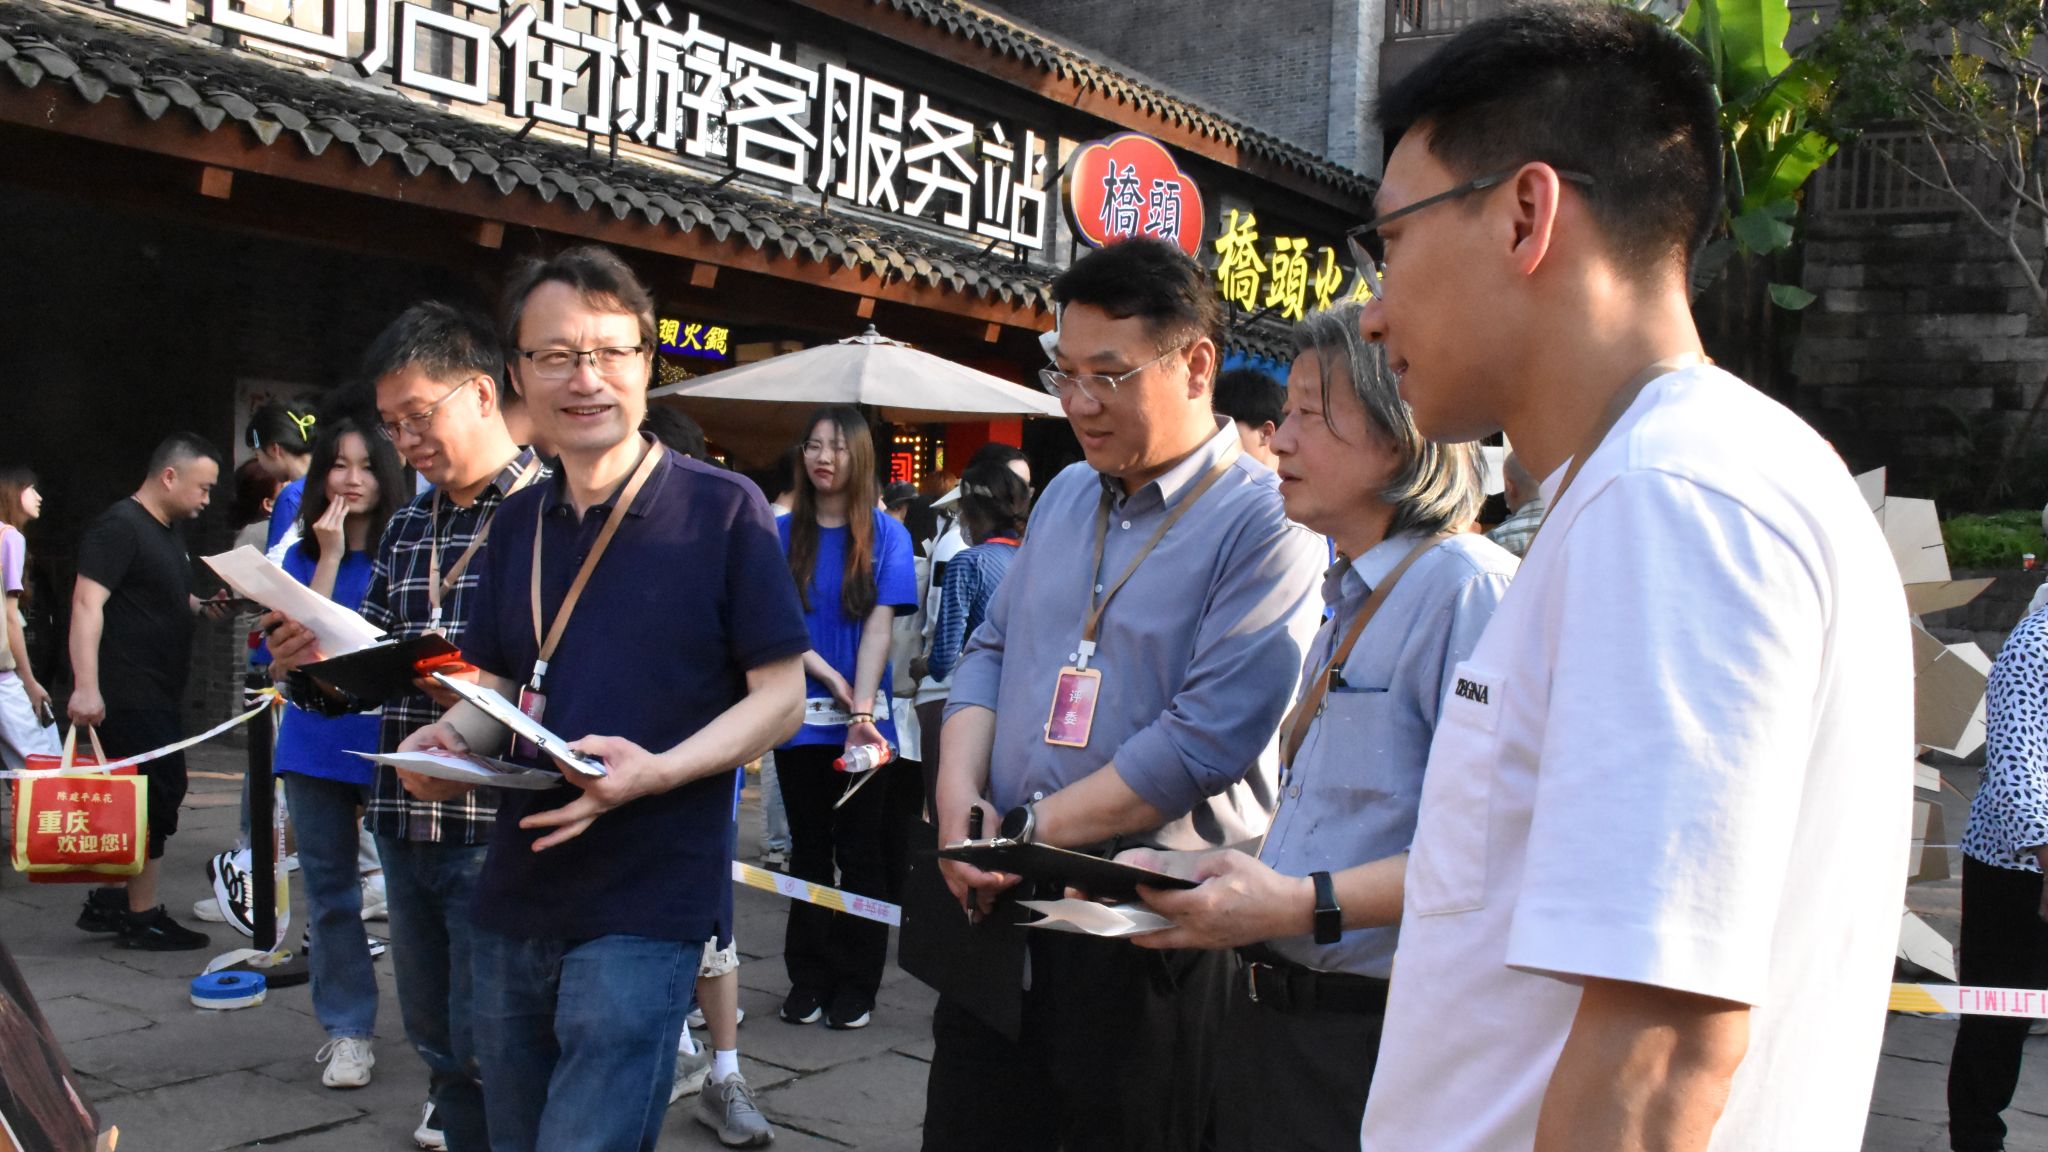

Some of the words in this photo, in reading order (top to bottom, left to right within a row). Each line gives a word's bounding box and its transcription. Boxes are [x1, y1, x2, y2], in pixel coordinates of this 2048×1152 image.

[1099, 158, 1183, 247] 橋頭
[1214, 208, 1383, 321] 橋頭火
[1455, 677, 1489, 705] ZEGNA
[37, 809, 90, 834] 重庆
[57, 833, 128, 853] 欢迎您!
